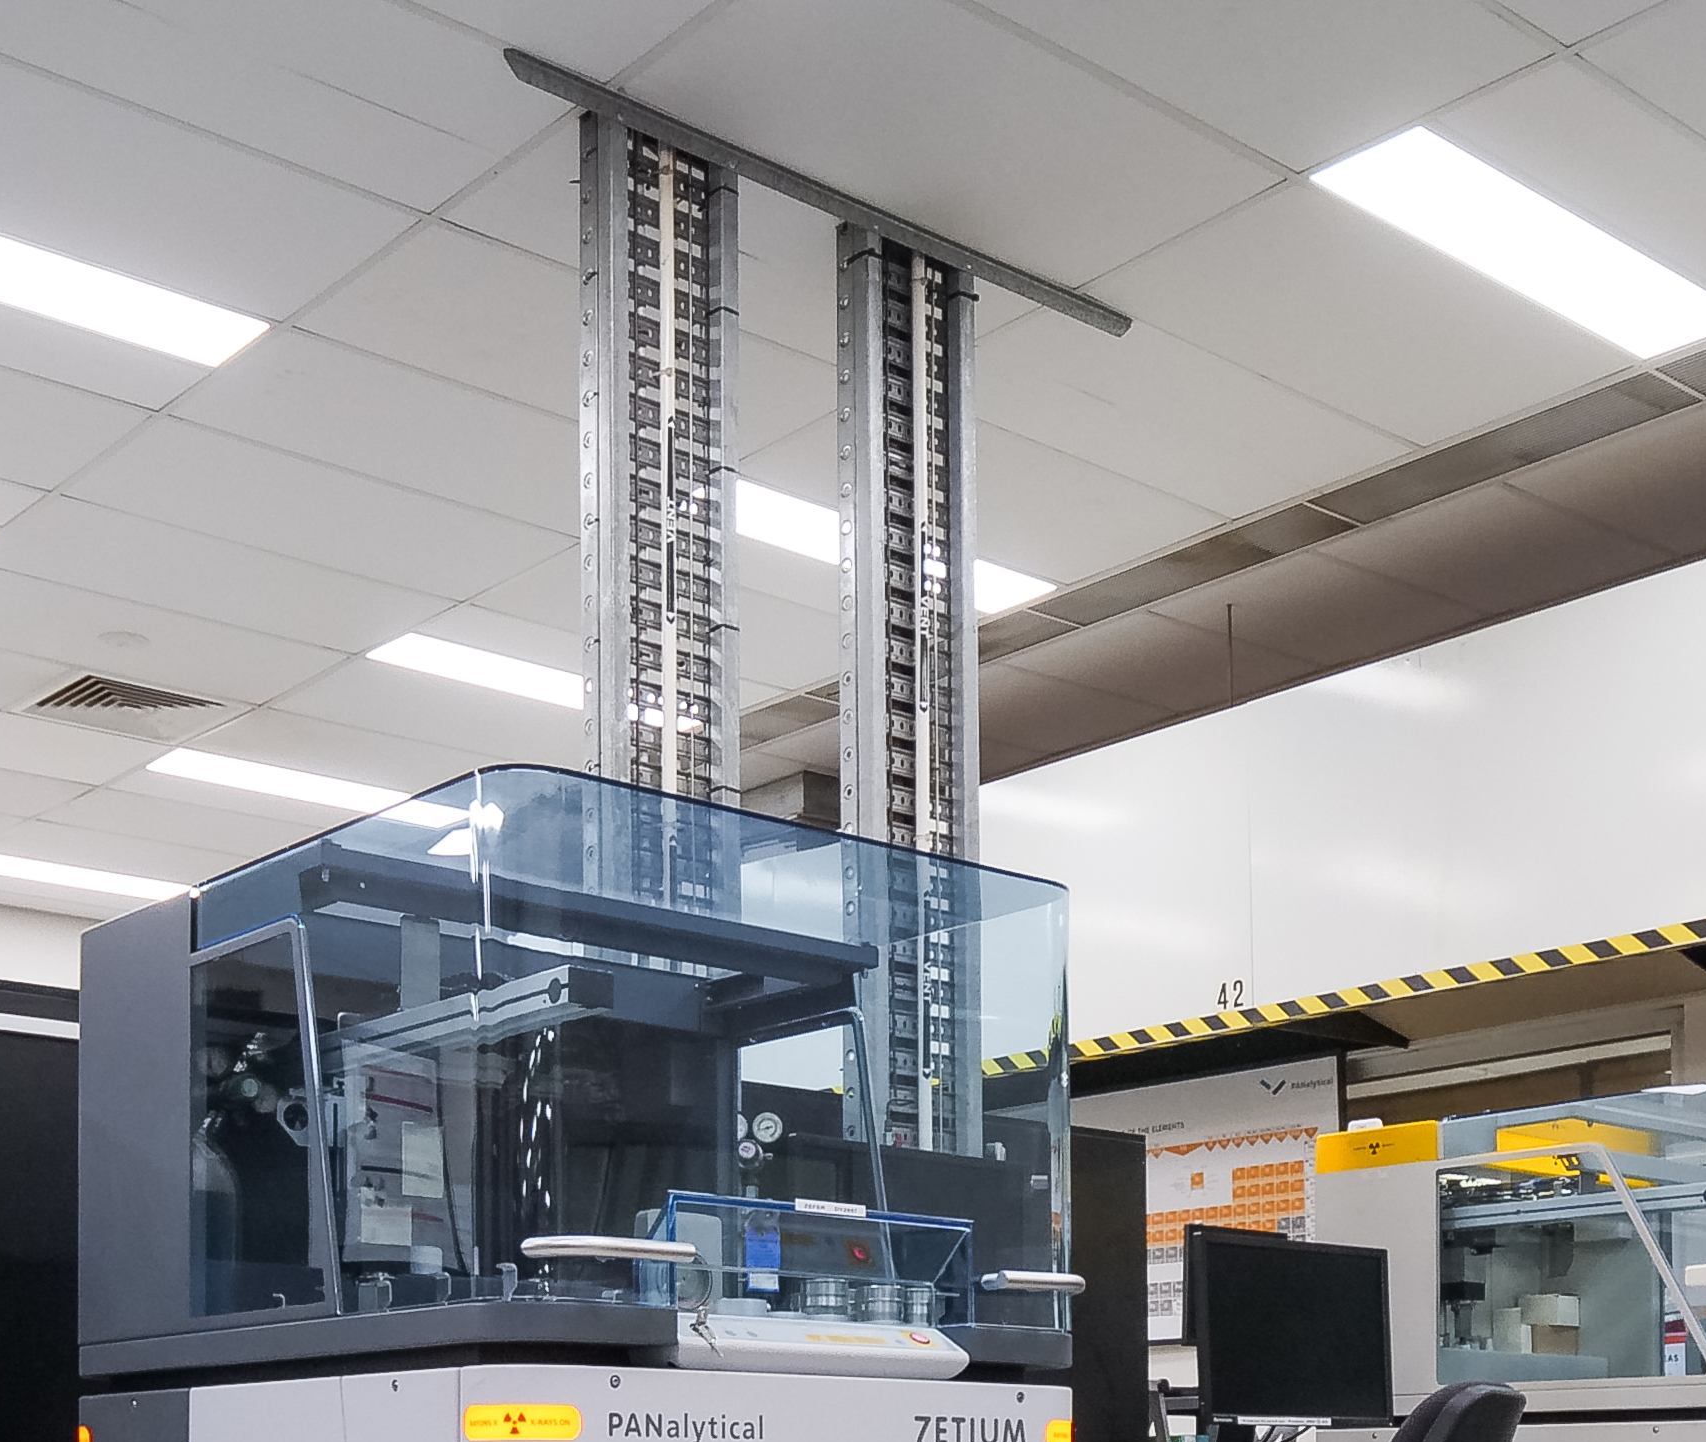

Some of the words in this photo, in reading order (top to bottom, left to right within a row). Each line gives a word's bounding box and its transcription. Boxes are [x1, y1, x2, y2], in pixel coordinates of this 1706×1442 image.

[666, 496, 676, 543] VENT
[920, 596, 931, 637] VENT
[922, 961, 932, 1004] VENT
[1217, 979, 1244, 1010] 42
[530, 1418, 558, 1426] X-RAYS
[560, 1418, 571, 1426] ON
